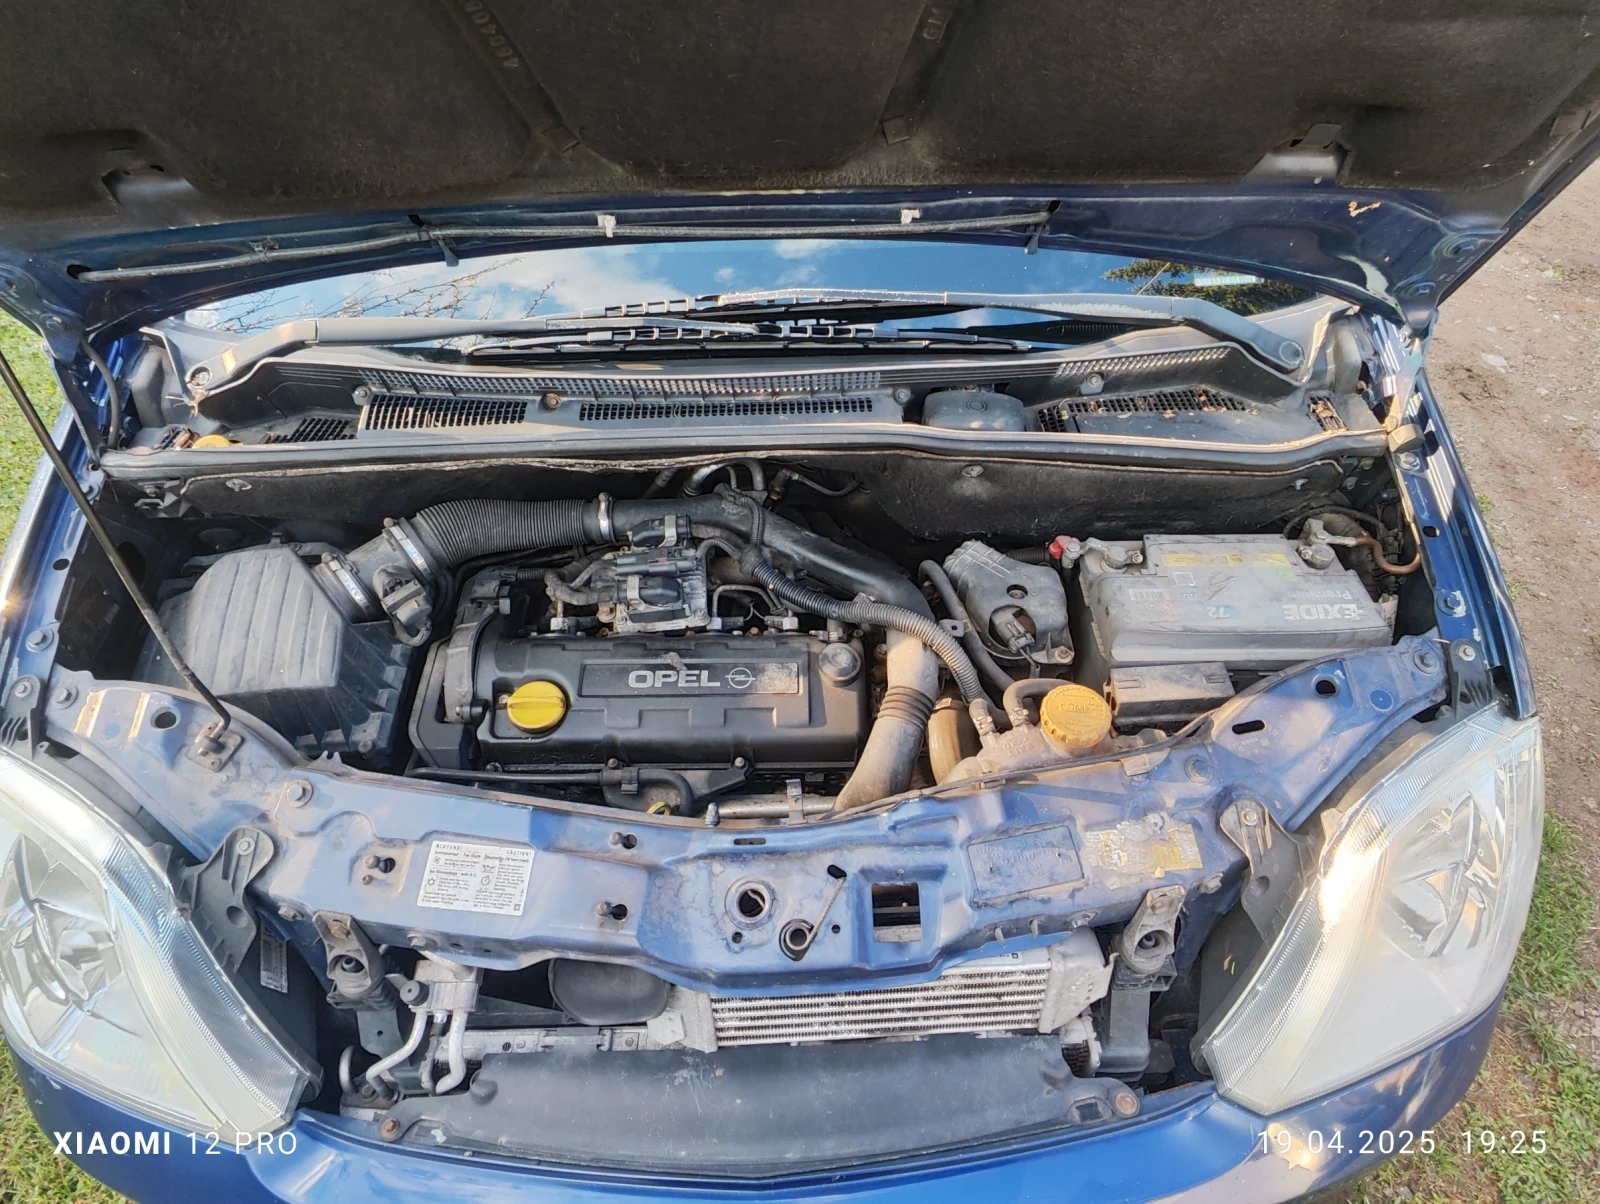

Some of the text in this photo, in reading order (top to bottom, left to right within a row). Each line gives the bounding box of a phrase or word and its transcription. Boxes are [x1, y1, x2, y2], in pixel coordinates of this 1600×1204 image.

[1288, 589, 1353, 600] Premium
[1206, 606, 1231, 618] 72
[1282, 604, 1364, 620] EXIDE
[628, 670, 721, 688] OPEL
